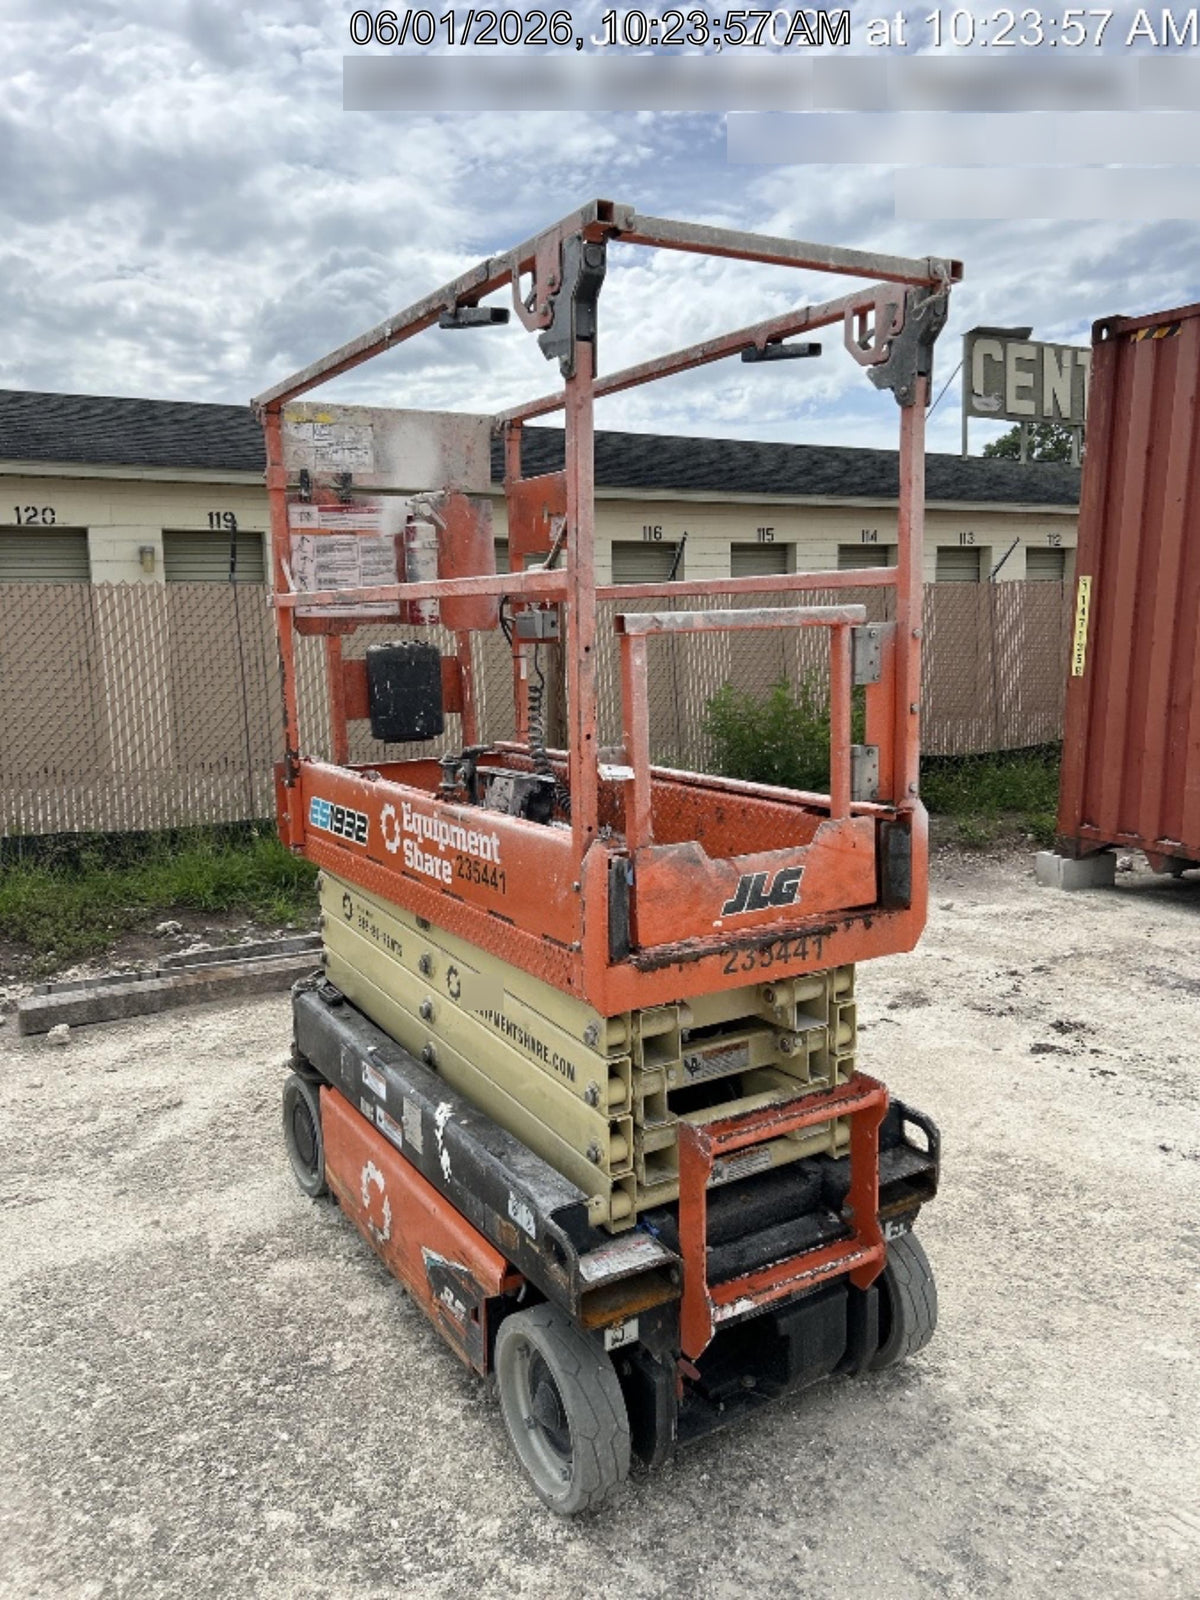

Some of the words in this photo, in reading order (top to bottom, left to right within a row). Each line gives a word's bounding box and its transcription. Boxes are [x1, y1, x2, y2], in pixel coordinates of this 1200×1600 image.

[14, 505, 56, 525] 120
[207, 511, 237, 529] 119
[643, 525, 662, 541] 116
[757, 527, 775, 542] 115
[861, 529, 878, 543] 114
[959, 532, 975, 545] 113
[309, 796, 370, 846] ES1932
[401, 801, 501, 864] Equipment
[402, 838, 453, 885] Share
[456, 854, 507, 895] 235441
[720, 865, 806, 918] JLG
